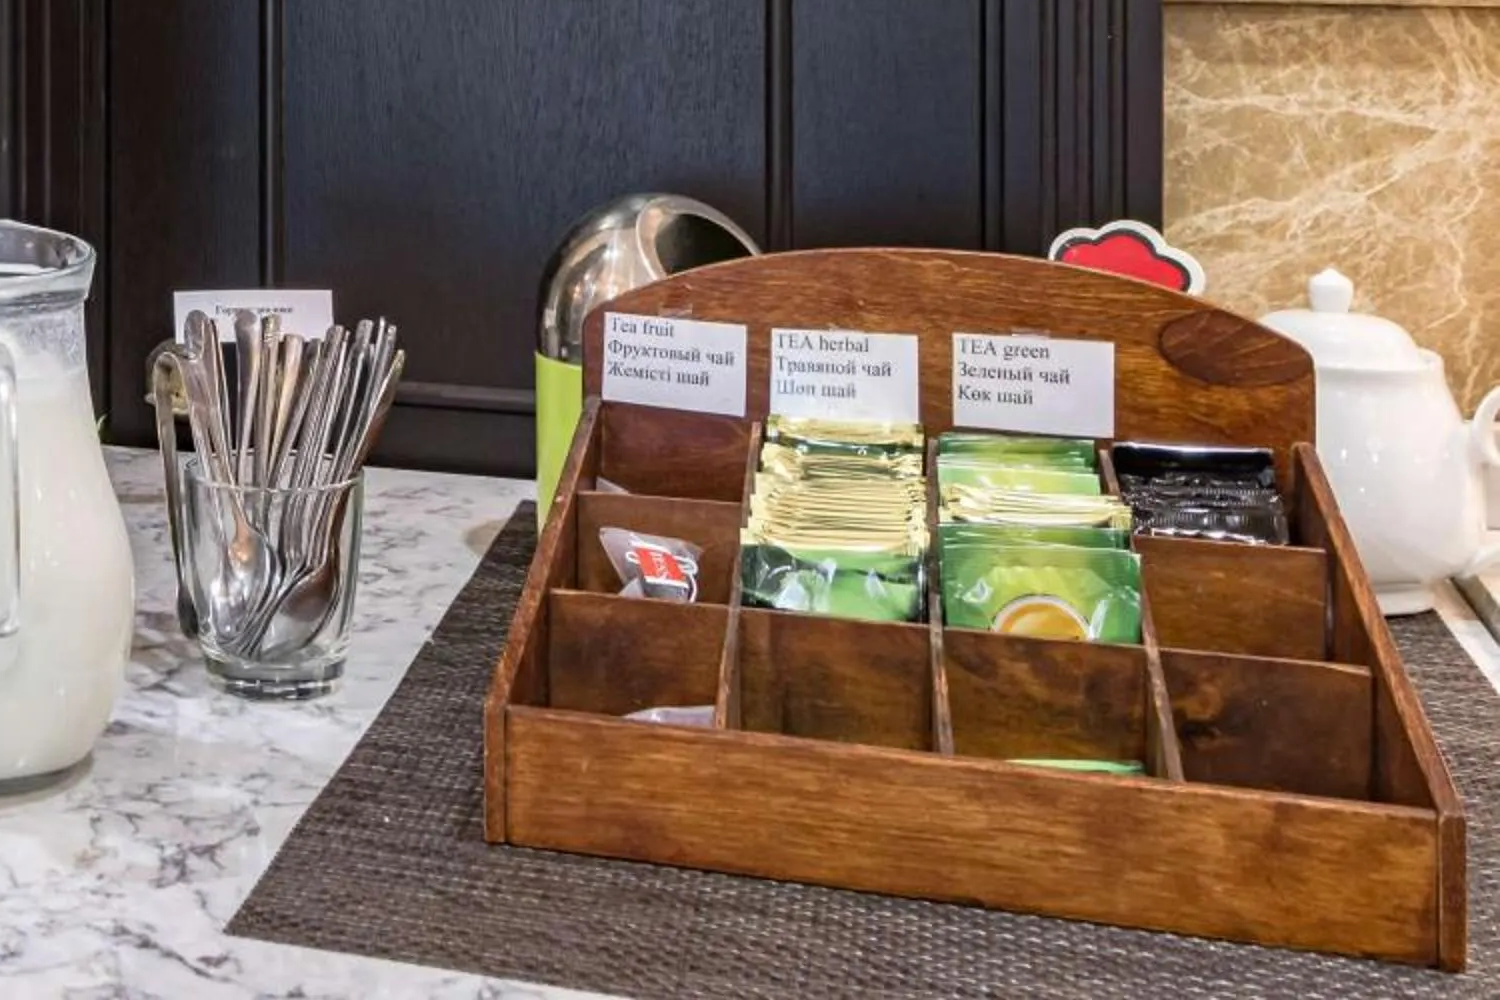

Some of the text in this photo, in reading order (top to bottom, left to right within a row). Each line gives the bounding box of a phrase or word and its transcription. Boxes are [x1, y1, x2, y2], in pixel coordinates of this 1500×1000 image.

[612, 317, 674, 337] Tea fruit
[607, 339, 735, 366] Фруктовый чай
[778, 333, 869, 353] TEA herbal
[959, 338, 1050, 361] TEA green
[776, 356, 892, 377] Травяной чай
[958, 362, 1070, 384] Зеленый чай
[676, 371, 709, 386] шай
[821, 383, 856, 398] шай
[997, 389, 1033, 405] шай
